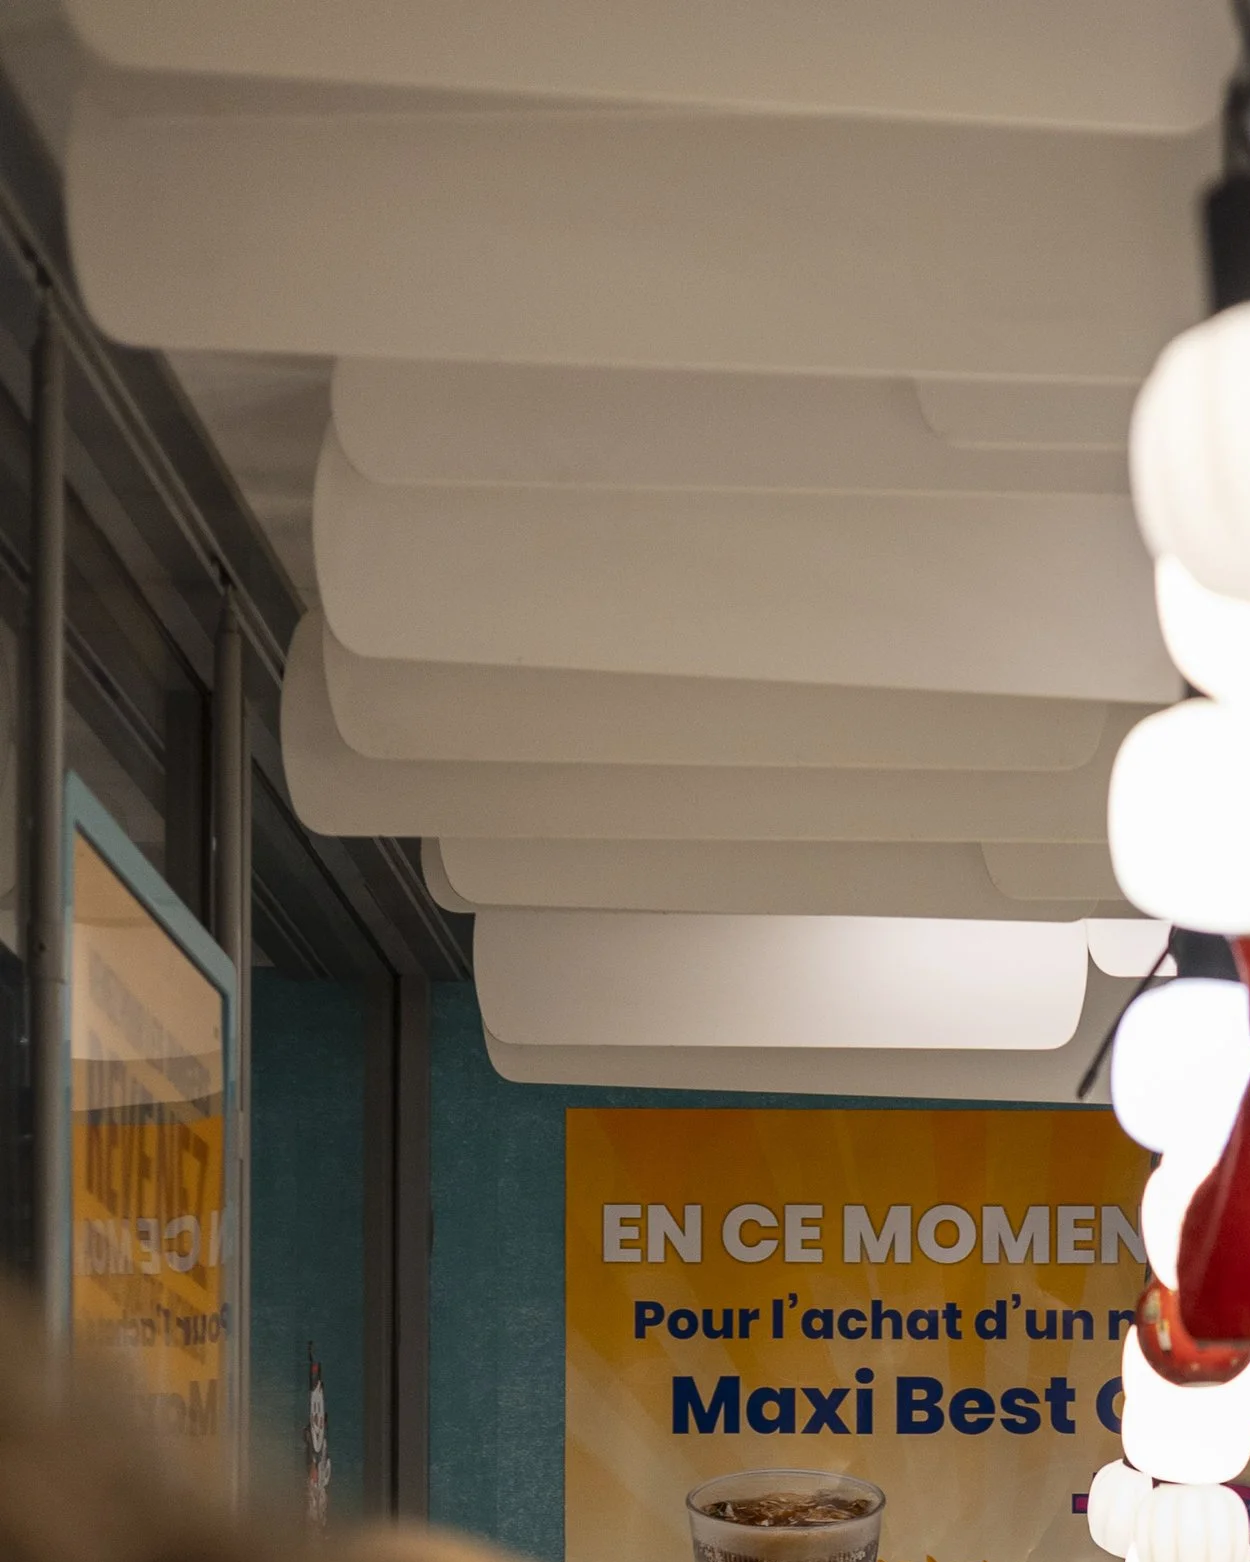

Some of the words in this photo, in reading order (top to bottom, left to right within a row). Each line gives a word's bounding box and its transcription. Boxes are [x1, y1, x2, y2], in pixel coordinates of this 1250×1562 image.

[602, 1203, 702, 1265] EN
[721, 1203, 825, 1266] CE
[842, 1203, 1148, 1266] MOMEN
[633, 1300, 760, 1341] Pour
[771, 1292, 962, 1341] l'achat
[973, 1294, 1094, 1341] d'un
[671, 1367, 874, 1436] Maxi
[895, 1376, 1076, 1436] Best
